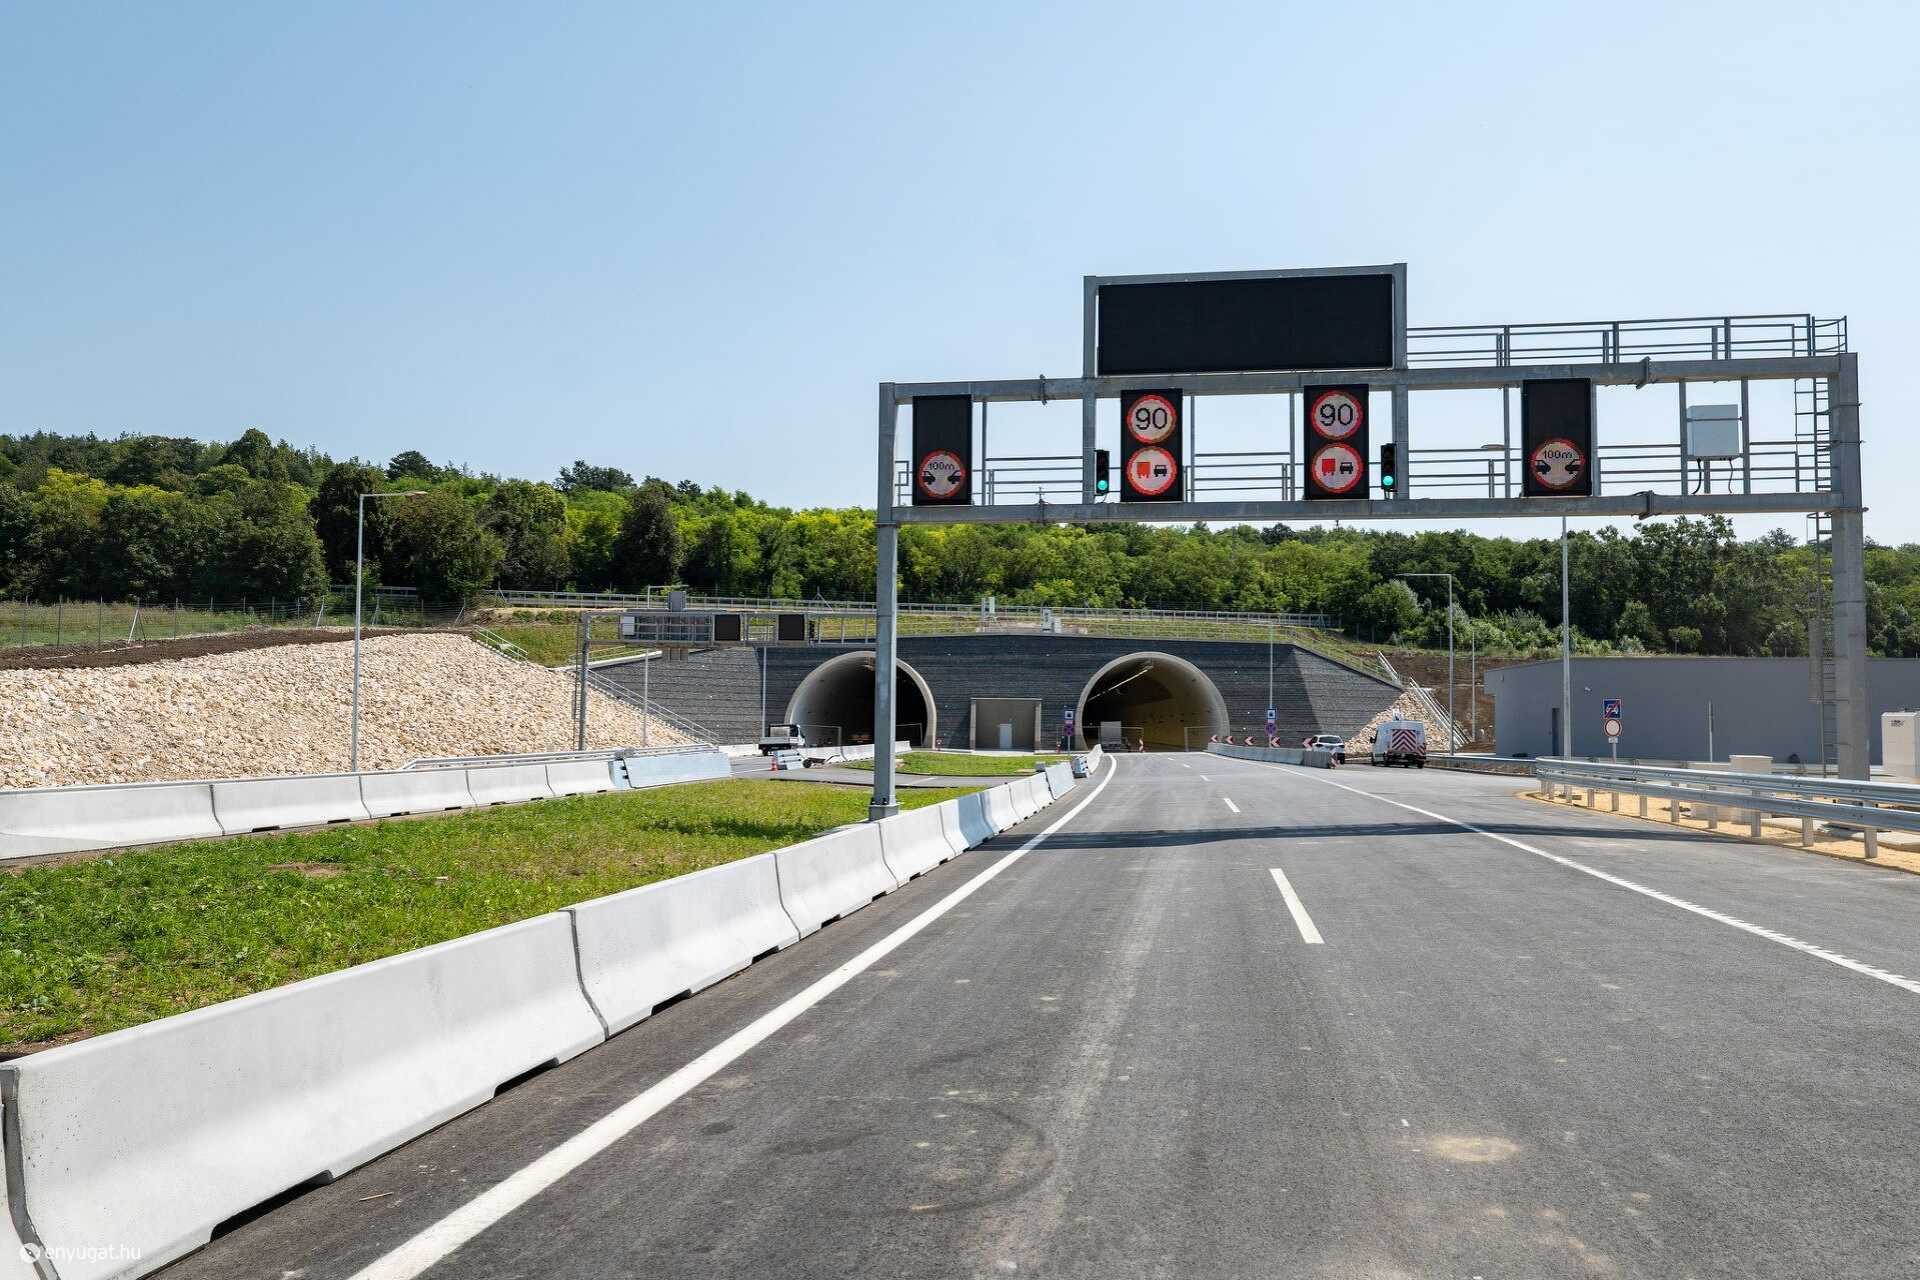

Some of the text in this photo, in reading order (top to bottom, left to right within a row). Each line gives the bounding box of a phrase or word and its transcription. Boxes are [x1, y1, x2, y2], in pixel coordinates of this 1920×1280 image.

[1135, 408, 1168, 430] 90
[1320, 404, 1353, 426] 90
[1543, 449, 1573, 460] 100m
[928, 461, 955, 471] 100m
